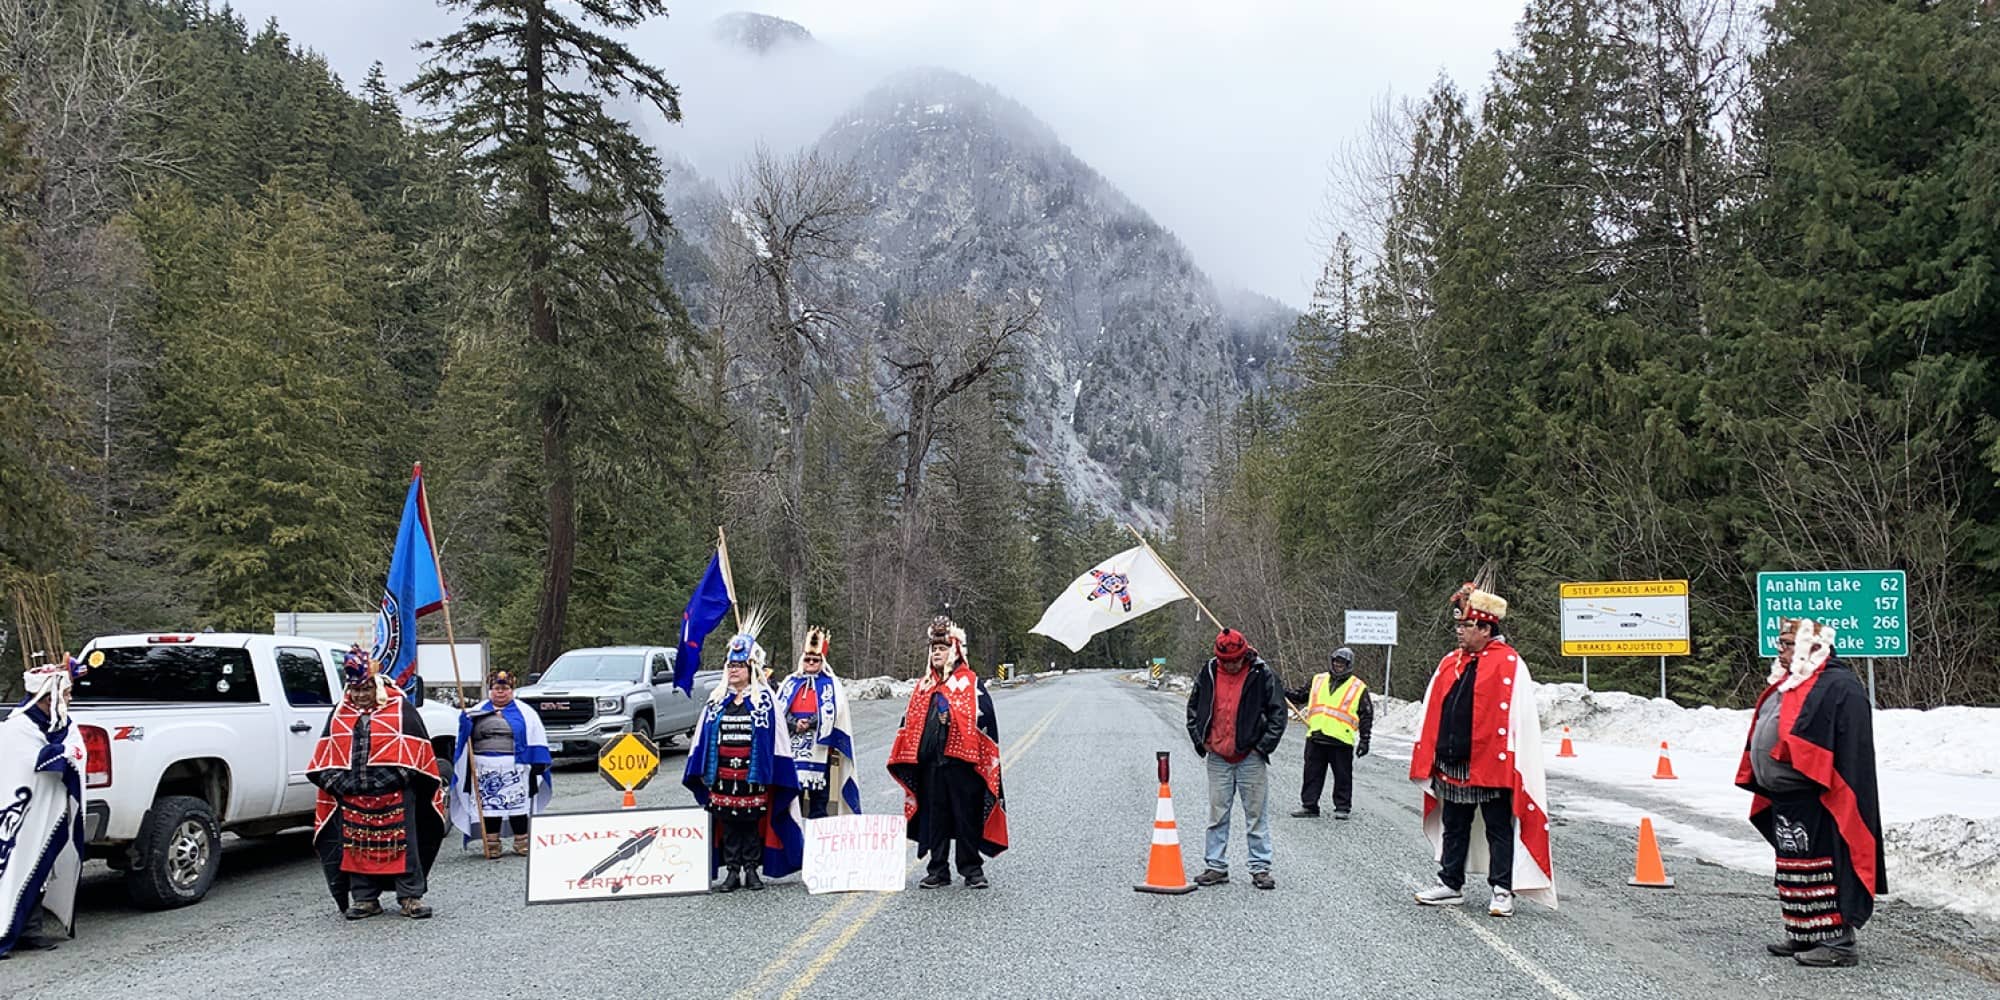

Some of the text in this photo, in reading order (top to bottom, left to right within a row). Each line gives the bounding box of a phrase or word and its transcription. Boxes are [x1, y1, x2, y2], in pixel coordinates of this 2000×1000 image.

[1572, 585, 1674, 595] STEEP GRADES AHEAD
[1766, 577, 1899, 593] Anahim Lake 62
[1766, 597, 1898, 611] Tatla Lake 157
[1873, 616, 1899, 629] 266
[1577, 643, 1612, 651] BRAKES
[1617, 642, 1663, 651] ADJUSTED
[1874, 635, 1901, 649] 379
[541, 702, 570, 710] GMC
[608, 755, 649, 770] SLOW
[536, 830, 620, 849] NUXALK
[817, 832, 897, 853] TERRITORY
[565, 874, 675, 889] TERRITORY
